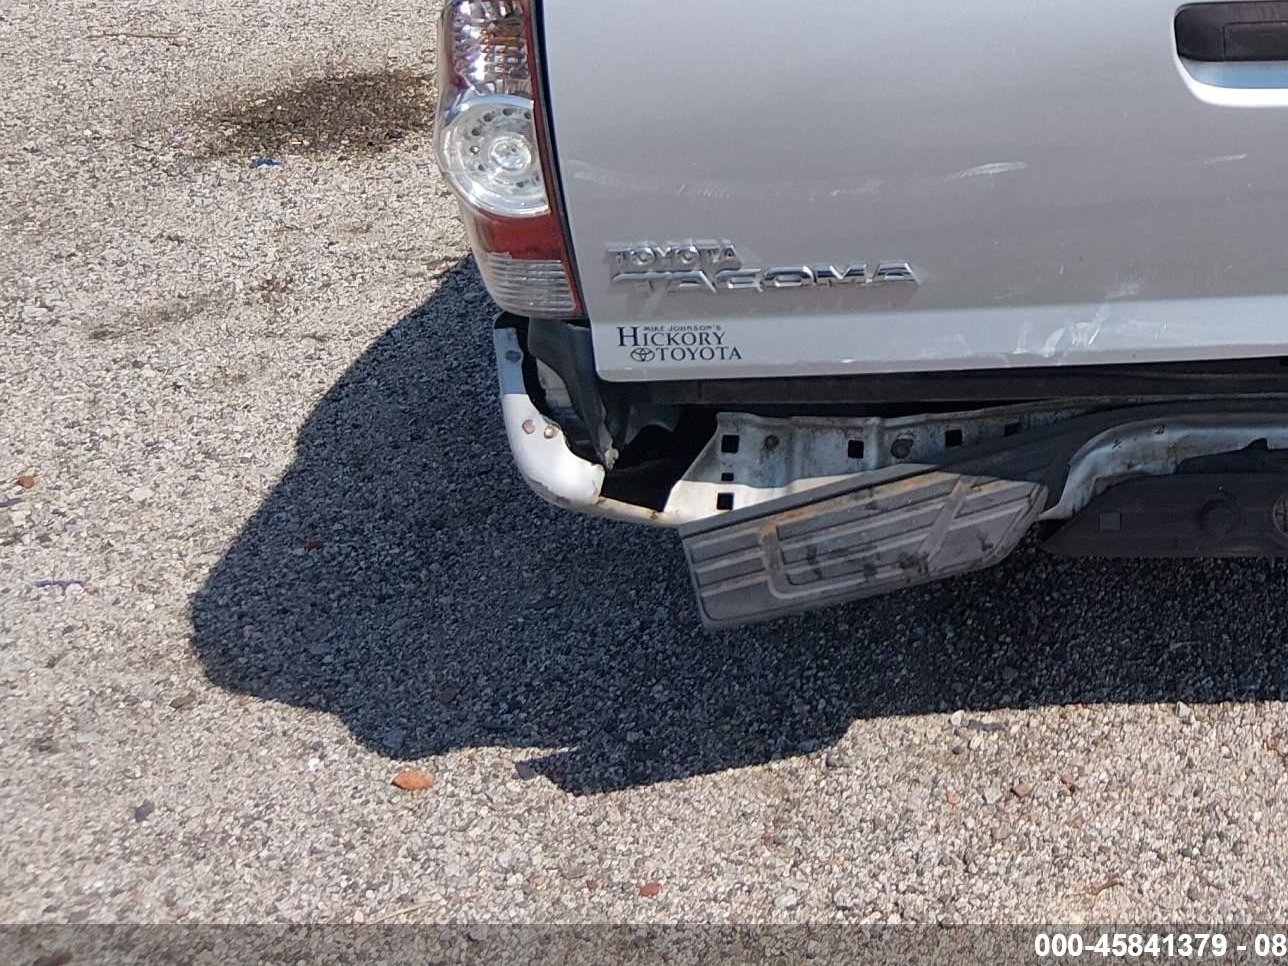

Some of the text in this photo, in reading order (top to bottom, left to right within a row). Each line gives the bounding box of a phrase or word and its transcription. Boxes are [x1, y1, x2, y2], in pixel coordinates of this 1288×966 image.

[606, 240, 740, 265] TOYOTA
[611, 261, 922, 293] TACOMA
[668, 324, 722, 332] JOHNSON'S
[655, 346, 743, 362] TOYOTA
